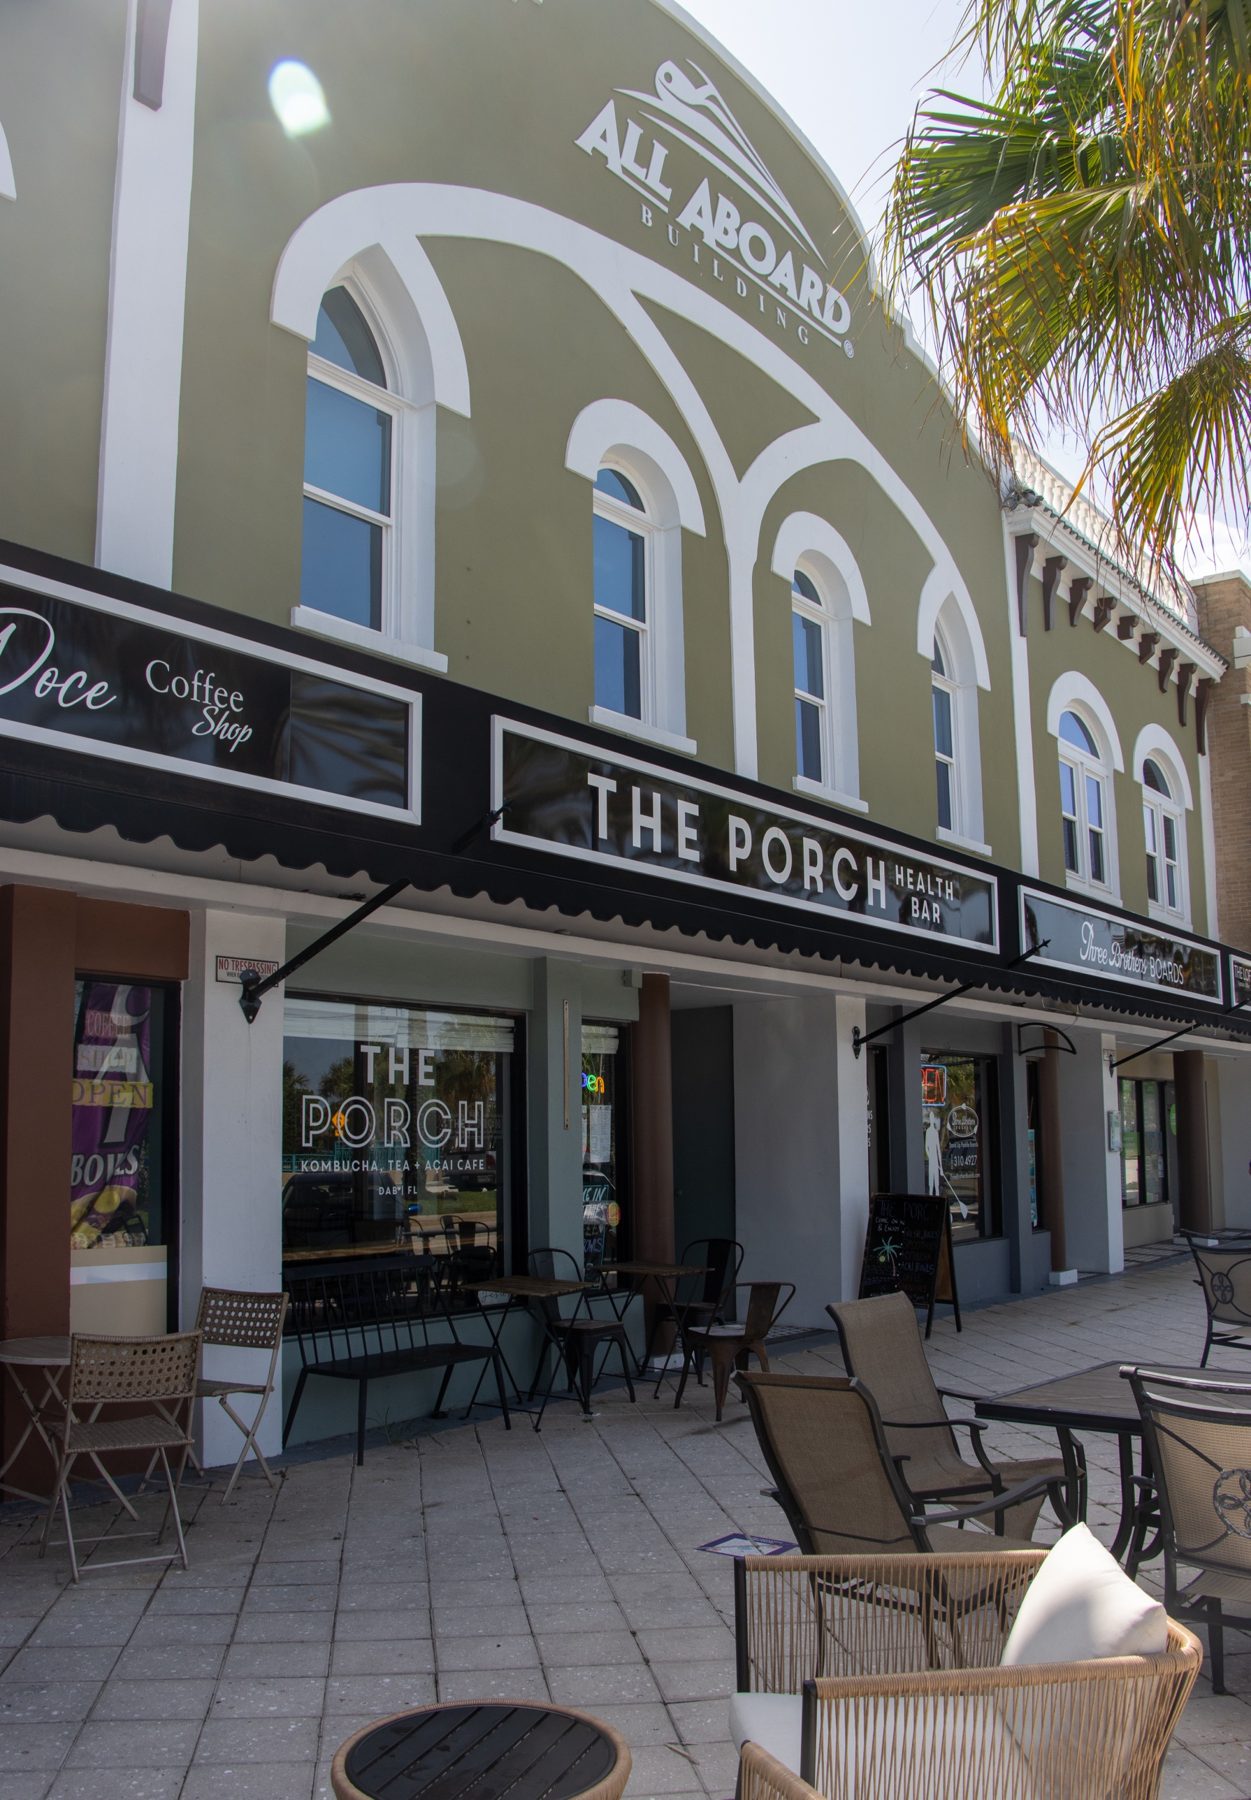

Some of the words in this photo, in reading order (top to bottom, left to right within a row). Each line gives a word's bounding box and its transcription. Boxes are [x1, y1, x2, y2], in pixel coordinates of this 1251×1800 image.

[573, 98, 672, 202] ALL
[675, 177, 851, 335] ABOARD
[640, 203, 809, 344] BUILDING
[145, 659, 244, 712] Coffee
[191, 706, 253, 752] Shop
[588, 772, 700, 863] THE
[728, 814, 887, 910] PORCH
[894, 864, 954, 902] HEALTH
[911, 895, 941, 925] BAR
[218, 958, 230, 971] NO
[1079, 921, 1108, 966] Three
[1108, 941, 1148, 975] Brothers
[1149, 956, 1184, 985] BOARDS
[360, 1045, 435, 1086] THE
[302, 1095, 485, 1148] PORCH
[301, 1159, 383, 1173] KOMBUCHA,
[388, 1159, 410, 1171] TEA
[457, 1159, 485, 1171] CAFE
[953, 1155, 964, 1167] 310
[964, 1154, 977, 1167] 4927
[407, 1185, 418, 1196] FL
